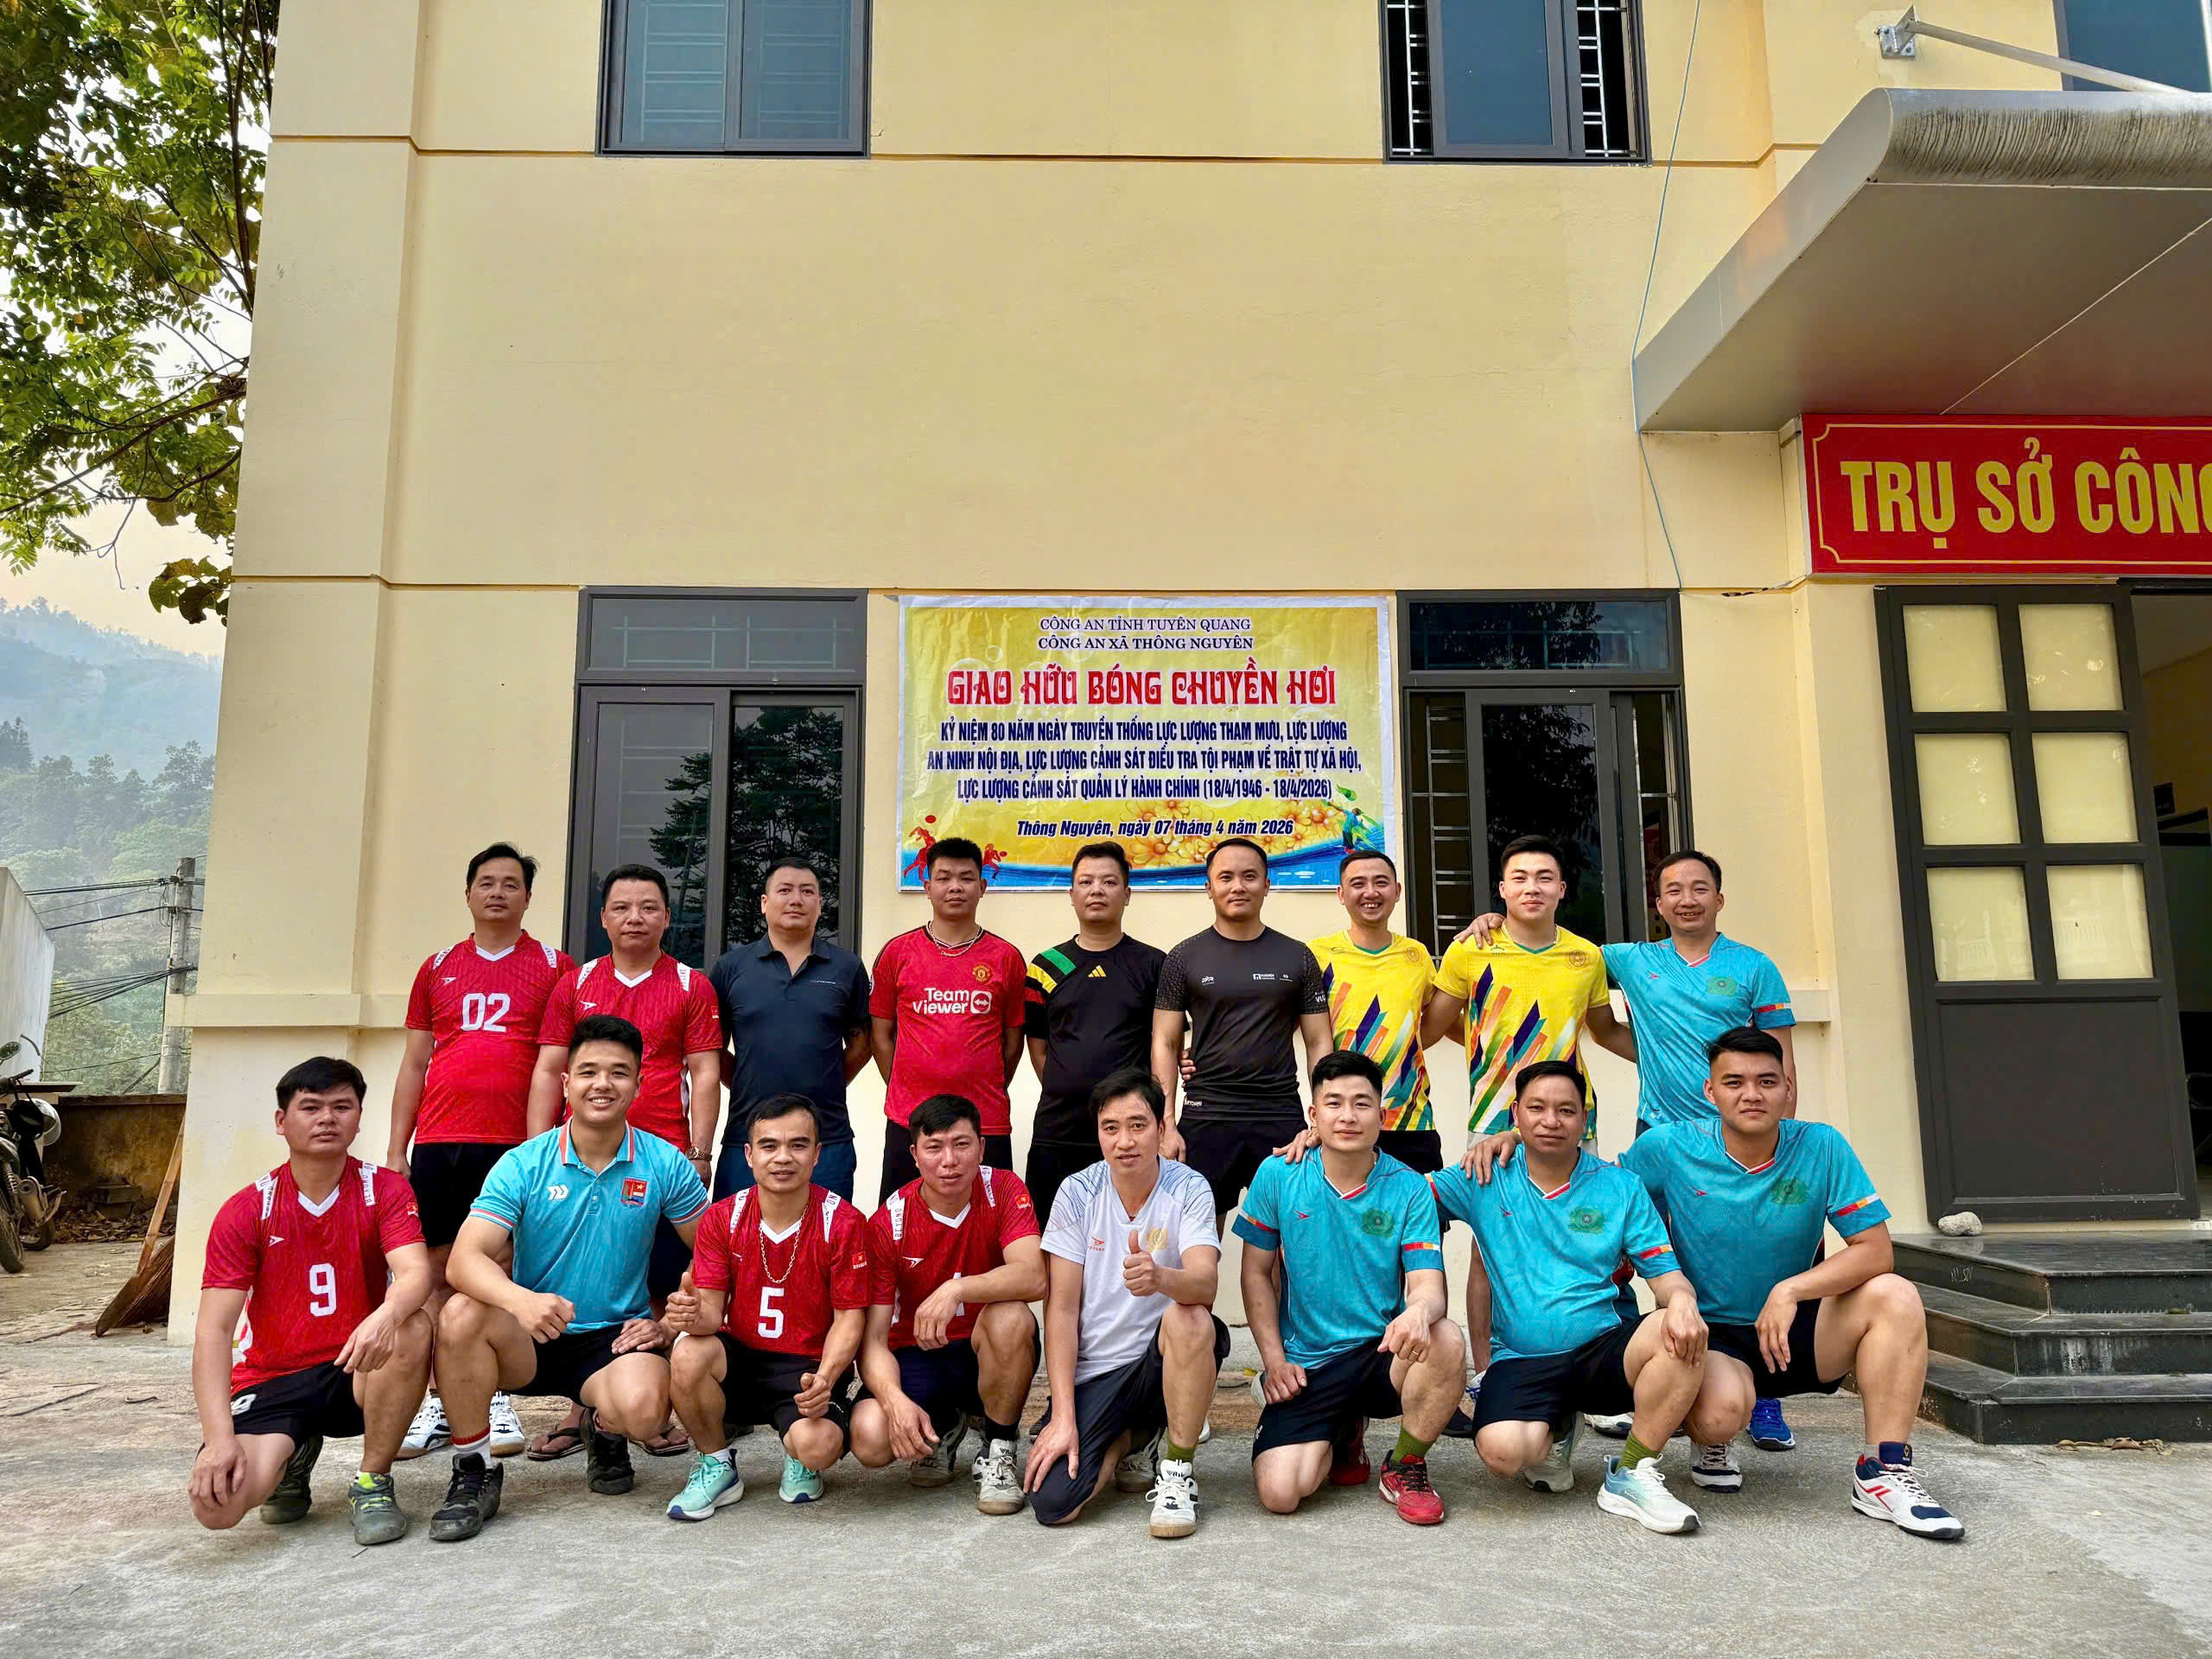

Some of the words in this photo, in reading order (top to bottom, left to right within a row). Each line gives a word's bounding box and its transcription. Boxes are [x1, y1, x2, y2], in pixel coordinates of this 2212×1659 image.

[1840, 461, 1955, 549] TRỤ
[1975, 436, 2055, 533] SỞ
[1040, 616, 1080, 630] CÔNG
[1084, 620, 1104, 630] AN
[1108, 615, 1143, 630] TỈNH
[1147, 616, 1196, 630] TUYÊN
[1200, 619, 1250, 632] QUANG
[1039, 635, 1081, 649] CÔNG
[1085, 638, 1105, 648] AN
[1109, 635, 1128, 648] XÃ
[1133, 635, 1185, 649] THÔNG
[1191, 635, 1253, 649] NGUYÊN
[947, 671, 1012, 705] GIAO
[1020, 663, 1077, 705] HỮU
[1088, 663, 1161, 705] BÓNG
[1172, 657, 1278, 705] CHUYỀN
[1286, 665, 1336, 705] HƠI
[941, 716, 956, 741] KỶ
[958, 718, 988, 745] NIỆM
[991, 722, 1005, 741] 80
[1007, 719, 1034, 741] NĂM
[1037, 718, 1067, 741] NGÀY
[1070, 715, 1113, 741] TRUYỀN
[1116, 715, 1153, 741] THỐNG
[1156, 721, 1177, 744] LỰC
[1180, 721, 1217, 744] LƯỢNG
[1219, 721, 1252, 741] THAM
[1255, 721, 1284, 742] MƯU,
[1287, 721, 1307, 744] LỰC
[1310, 721, 1347, 744] LƯỢNG
[927, 751, 943, 769] AN
[946, 751, 974, 770] NINH
[977, 747, 997, 773] NỘI
[1001, 751, 1023, 773] ĐỊA,
[1026, 750, 1046, 773] LỰC
[1051, 750, 1087, 773] LƯỢNG
[1090, 745, 1121, 770] CẢNH
[1124, 747, 1145, 770] SÁT
[1177, 750, 1198, 769] TRA
[1200, 747, 1218, 773] TỘI
[1222, 750, 1252, 772] PHẠM
[1257, 744, 1271, 769] VỀ
[1274, 747, 1302, 772] TRẬT
[1304, 749, 1319, 772] TỰ
[1321, 747, 1336, 769] XÃ
[1339, 747, 1362, 772] HỘI,
[957, 779, 979, 803] LỰC
[982, 779, 1019, 803] LƯỢNG
[1022, 774, 1053, 798] CẢNH
[1057, 775, 1077, 798] SÁT
[1081, 773, 1112, 800] QUẢN
[1115, 776, 1128, 798] LÝ
[1131, 775, 1162, 798] HÀNH
[1165, 775, 1200, 798] CHÍNH
[1204, 779, 1262, 799] (18/4/1946
[1273, 779, 1332, 799] 18/4/2026)
[1017, 820, 1058, 836] Thông
[1060, 820, 1114, 837] Nguyên,
[1118, 820, 1150, 836] ngày
[1154, 820, 1173, 835] 07
[1174, 820, 1211, 836] tháng
[1215, 820, 1224, 834] 4
[1227, 820, 1257, 835] năm
[1261, 820, 1294, 834] 2026
[912, 1001, 969, 1015] Viewer
[924, 988, 969, 1001] Team
[461, 993, 511, 1033] 02
[894, 1208, 903, 1237] BEYOND
[308, 1262, 338, 1317] 9
[757, 1286, 785, 1339] 5
